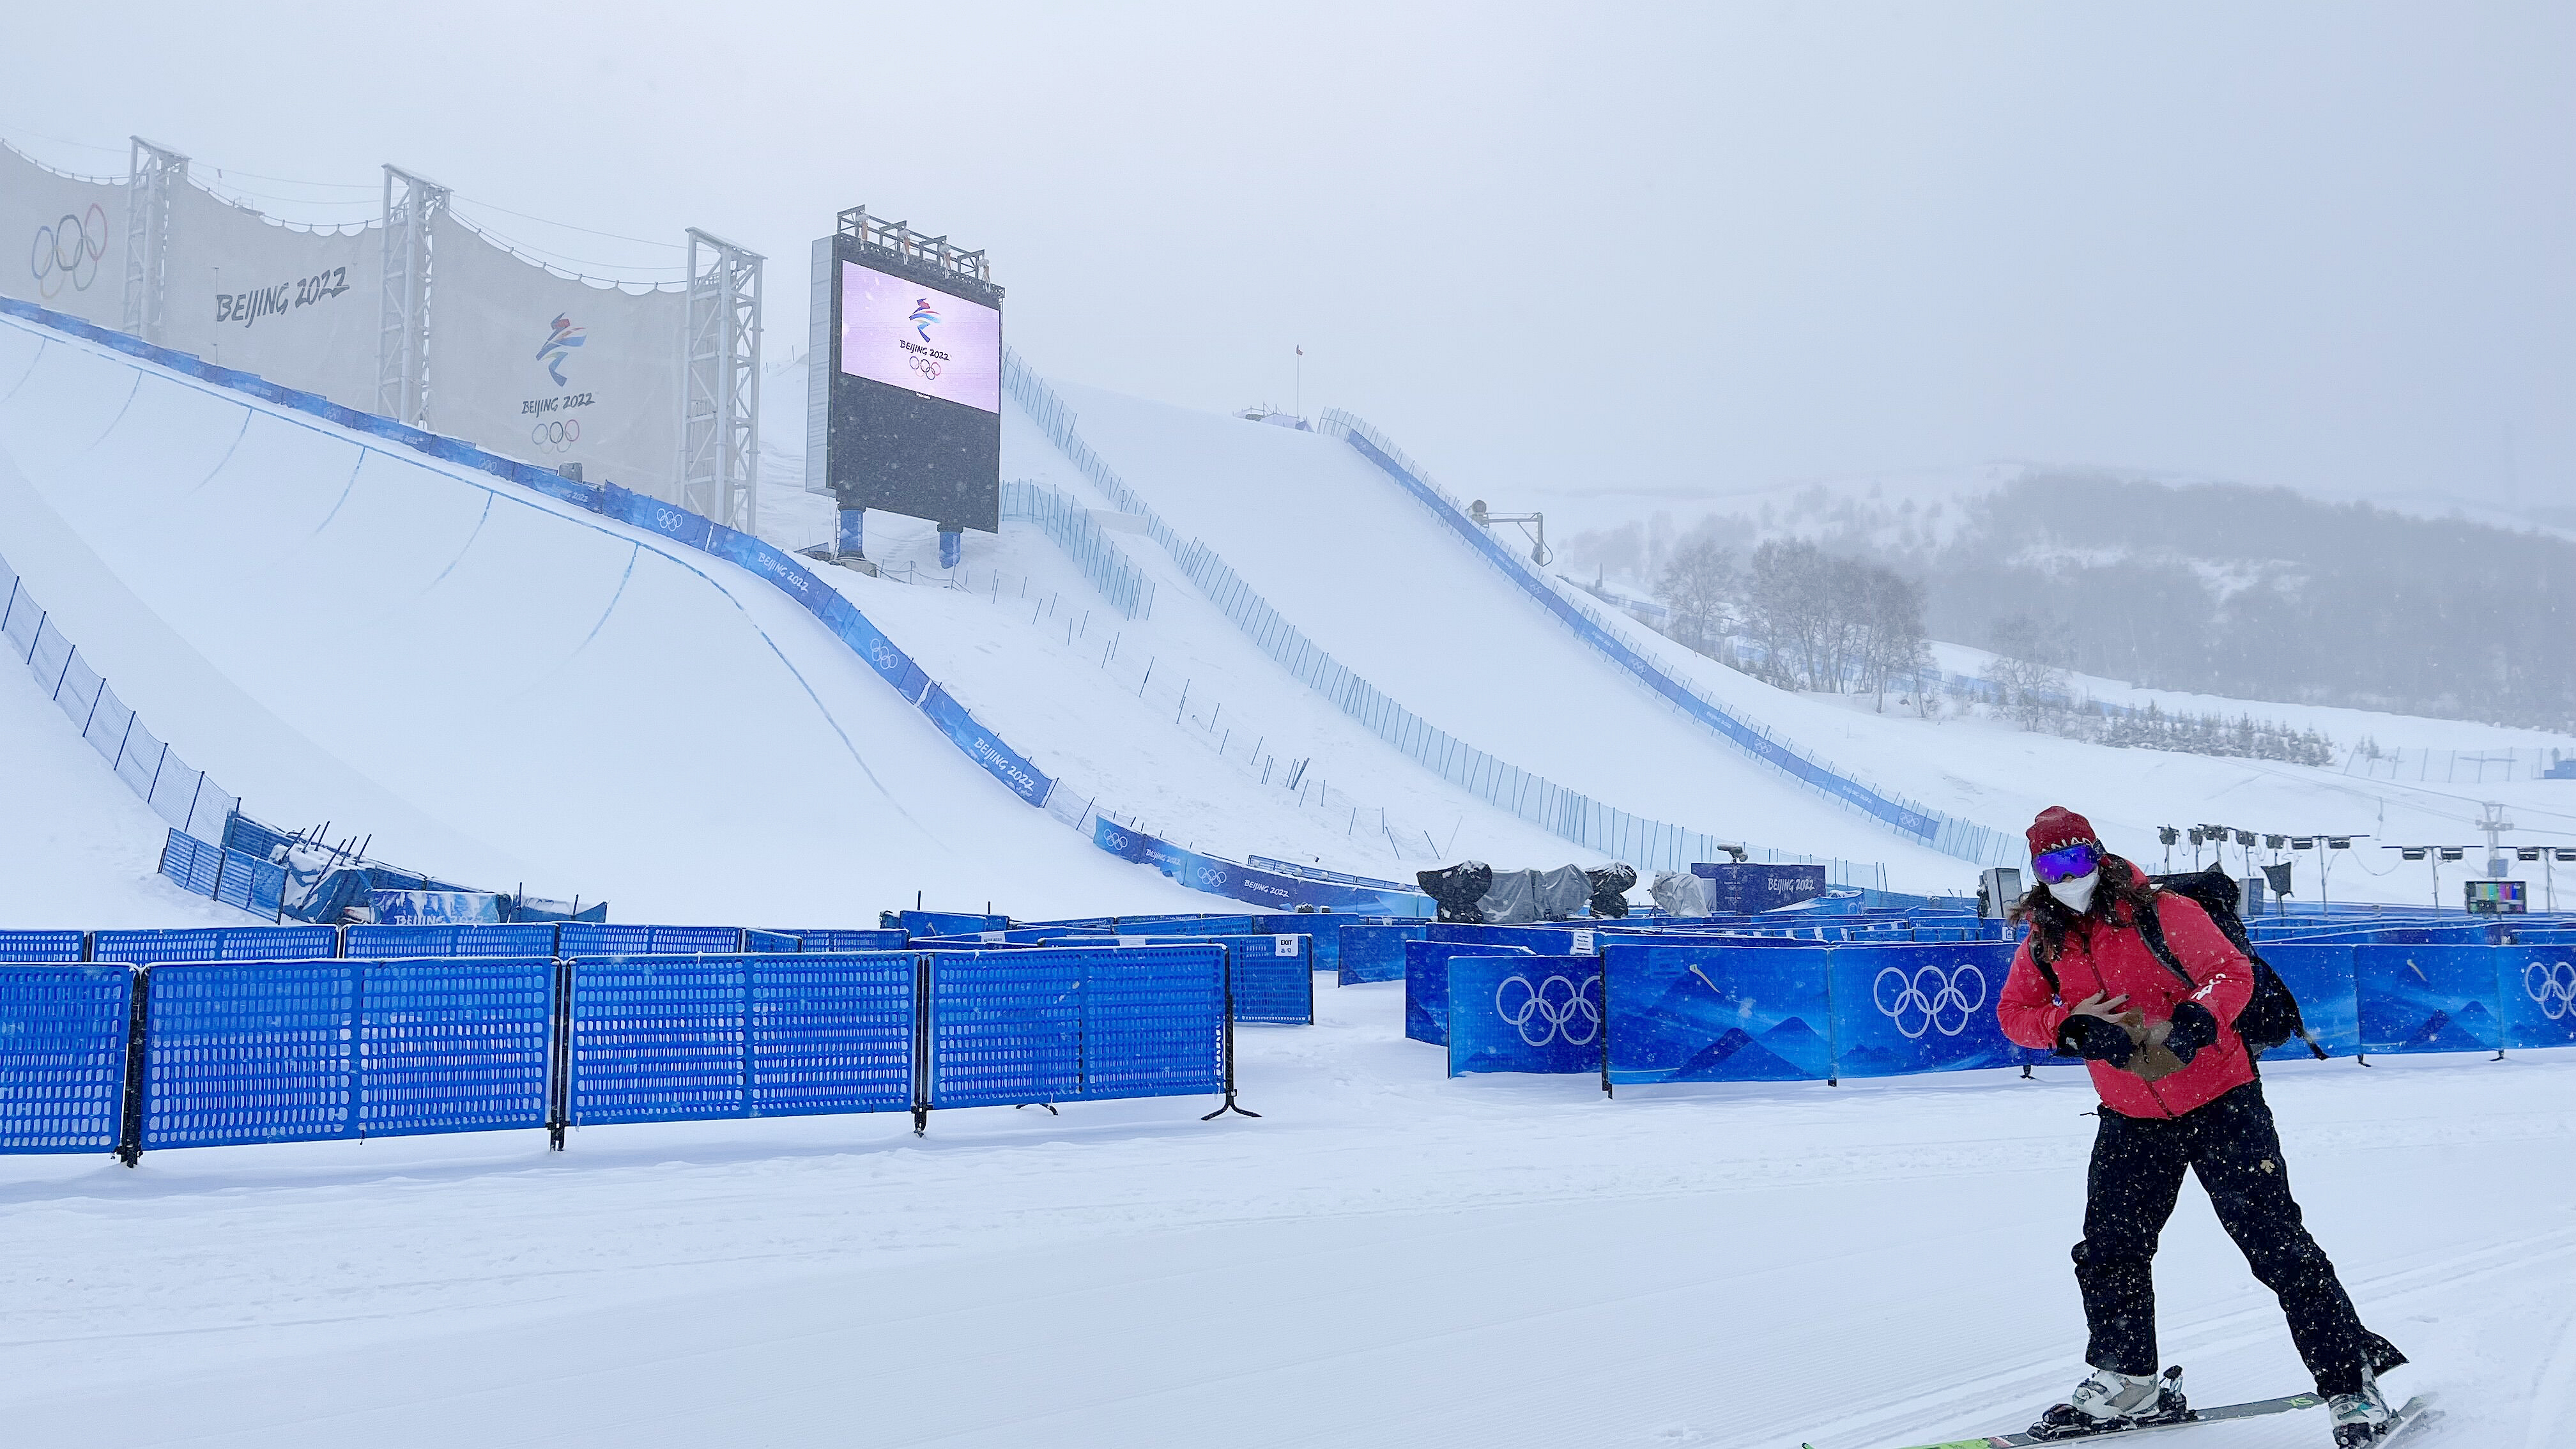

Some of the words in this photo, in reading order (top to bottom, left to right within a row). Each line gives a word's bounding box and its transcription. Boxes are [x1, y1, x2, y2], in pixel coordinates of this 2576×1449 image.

[217, 282, 289, 328] BEIJING
[295, 266, 350, 308] 2022
[900, 339, 928, 356] BEIJING
[929, 349, 951, 361] 2022
[521, 397, 559, 418] BEIJING
[562, 392, 595, 410] 2022
[758, 551, 788, 578] BEIJING
[786, 571, 809, 593] 2022
[974, 737, 1009, 770] BEIJING
[1007, 765, 1035, 793] 2022
[1146, 848, 1167, 862] BEIJING
[1166, 856, 1181, 866] 2022
[1244, 879, 1269, 893] BEIJING
[1269, 887, 1290, 898] 2022
[1767, 878, 1795, 895] BEIJING
[1795, 878, 1816, 892] 2022
